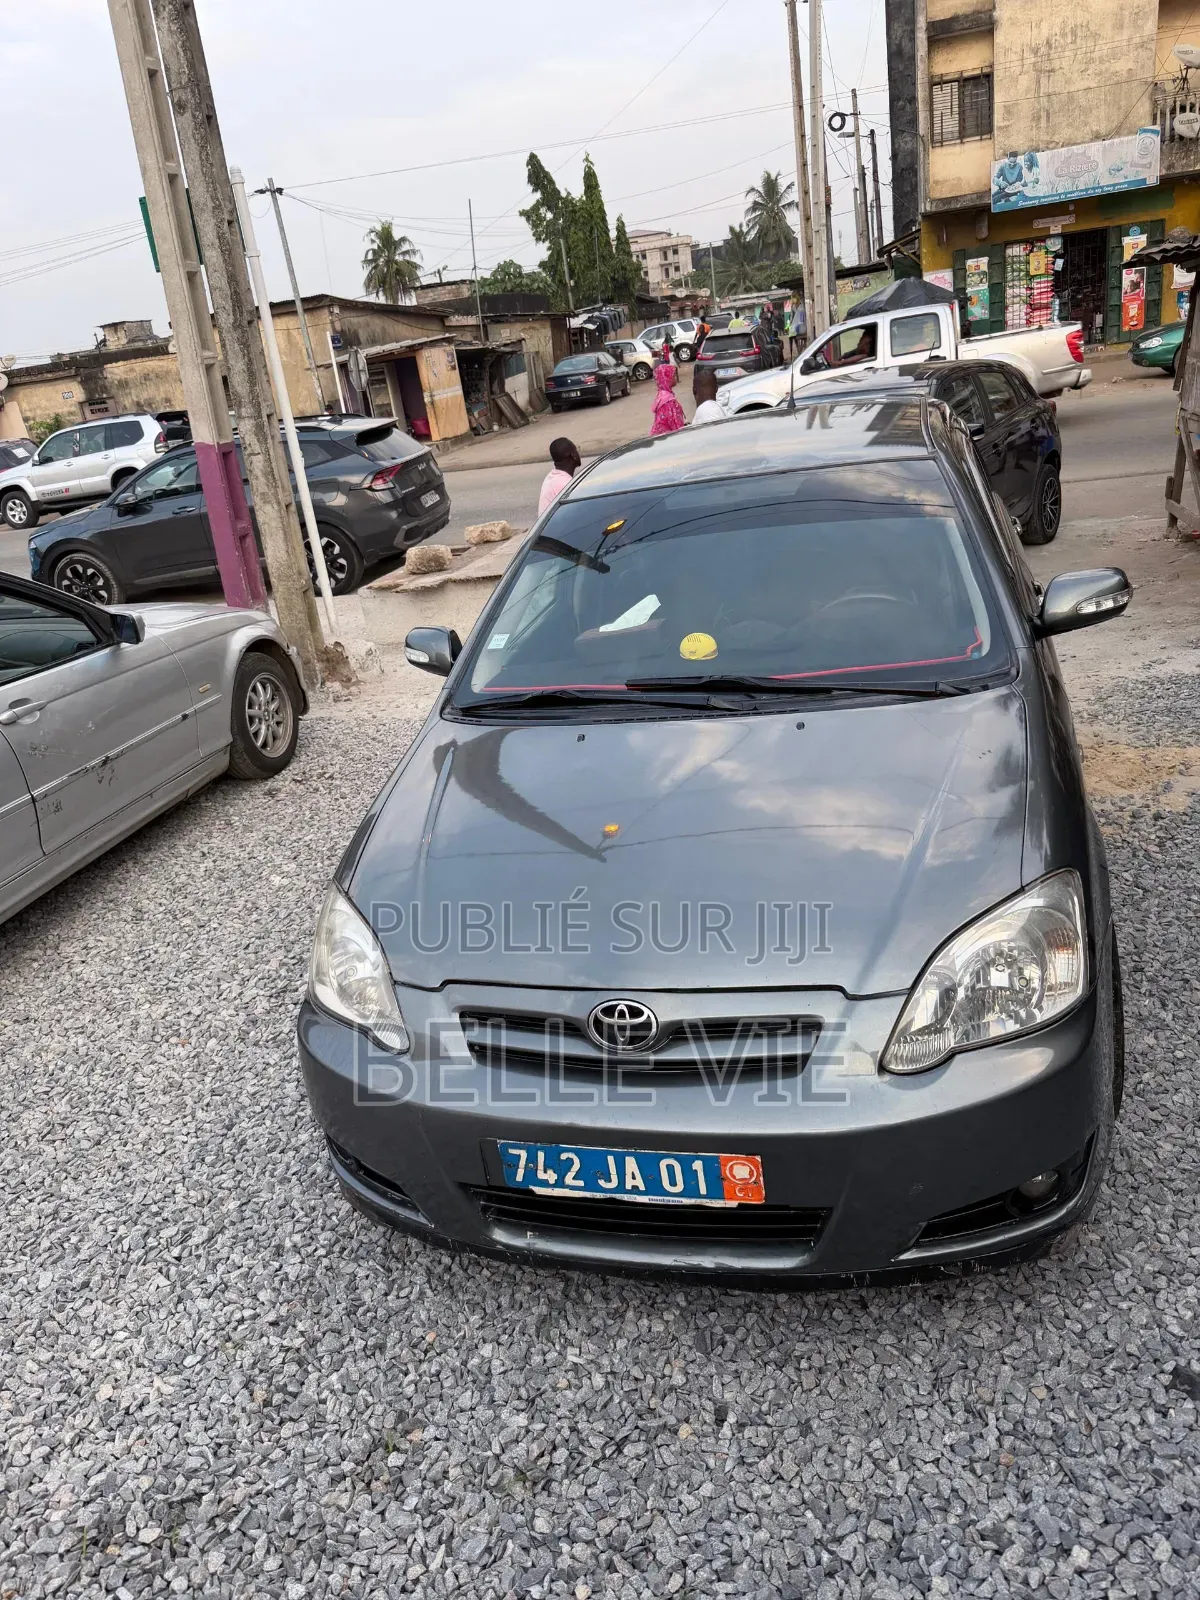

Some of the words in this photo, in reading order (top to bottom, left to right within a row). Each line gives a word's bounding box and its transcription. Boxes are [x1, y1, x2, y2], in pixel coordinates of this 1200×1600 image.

[1058, 167, 1067, 175] La
[508, 1148, 585, 1187] 742
[597, 1155, 646, 1191] JA
[659, 1158, 707, 1195] 01
